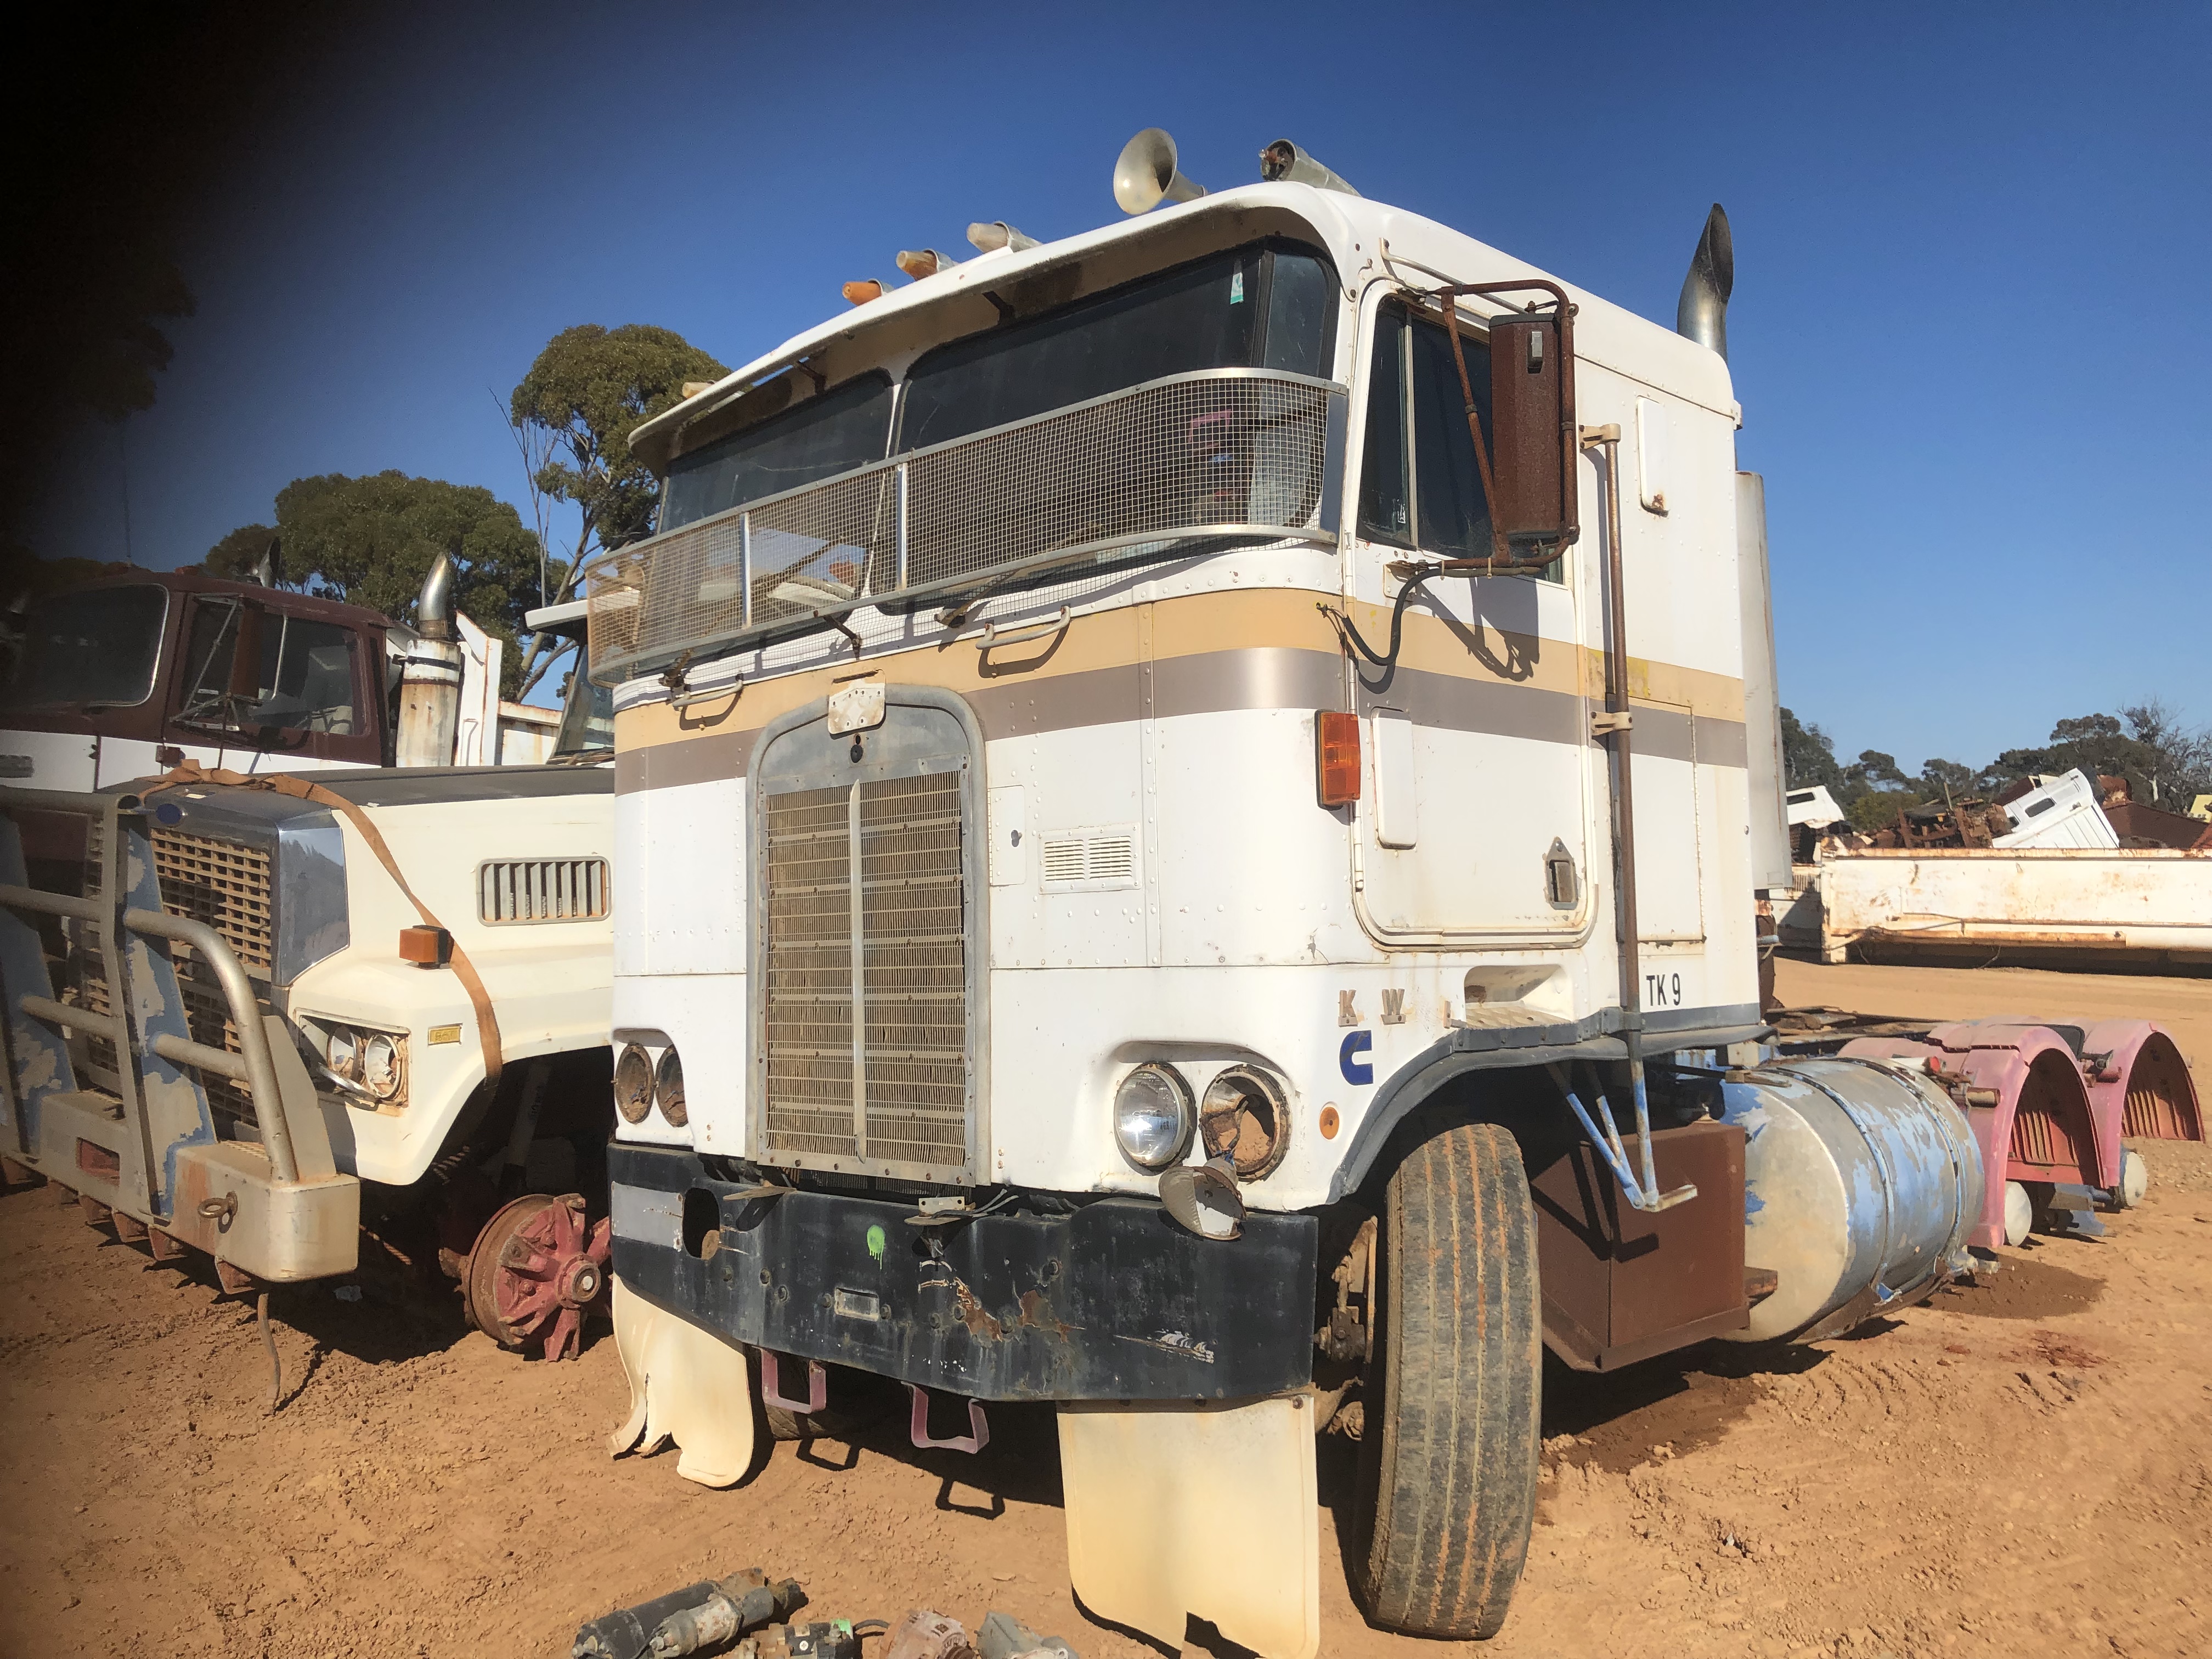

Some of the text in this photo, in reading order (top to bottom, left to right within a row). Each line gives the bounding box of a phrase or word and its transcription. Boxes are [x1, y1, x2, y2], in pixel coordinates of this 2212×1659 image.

[1339, 988, 1405, 1018] K W
[1646, 973, 1680, 1006] TK 9
